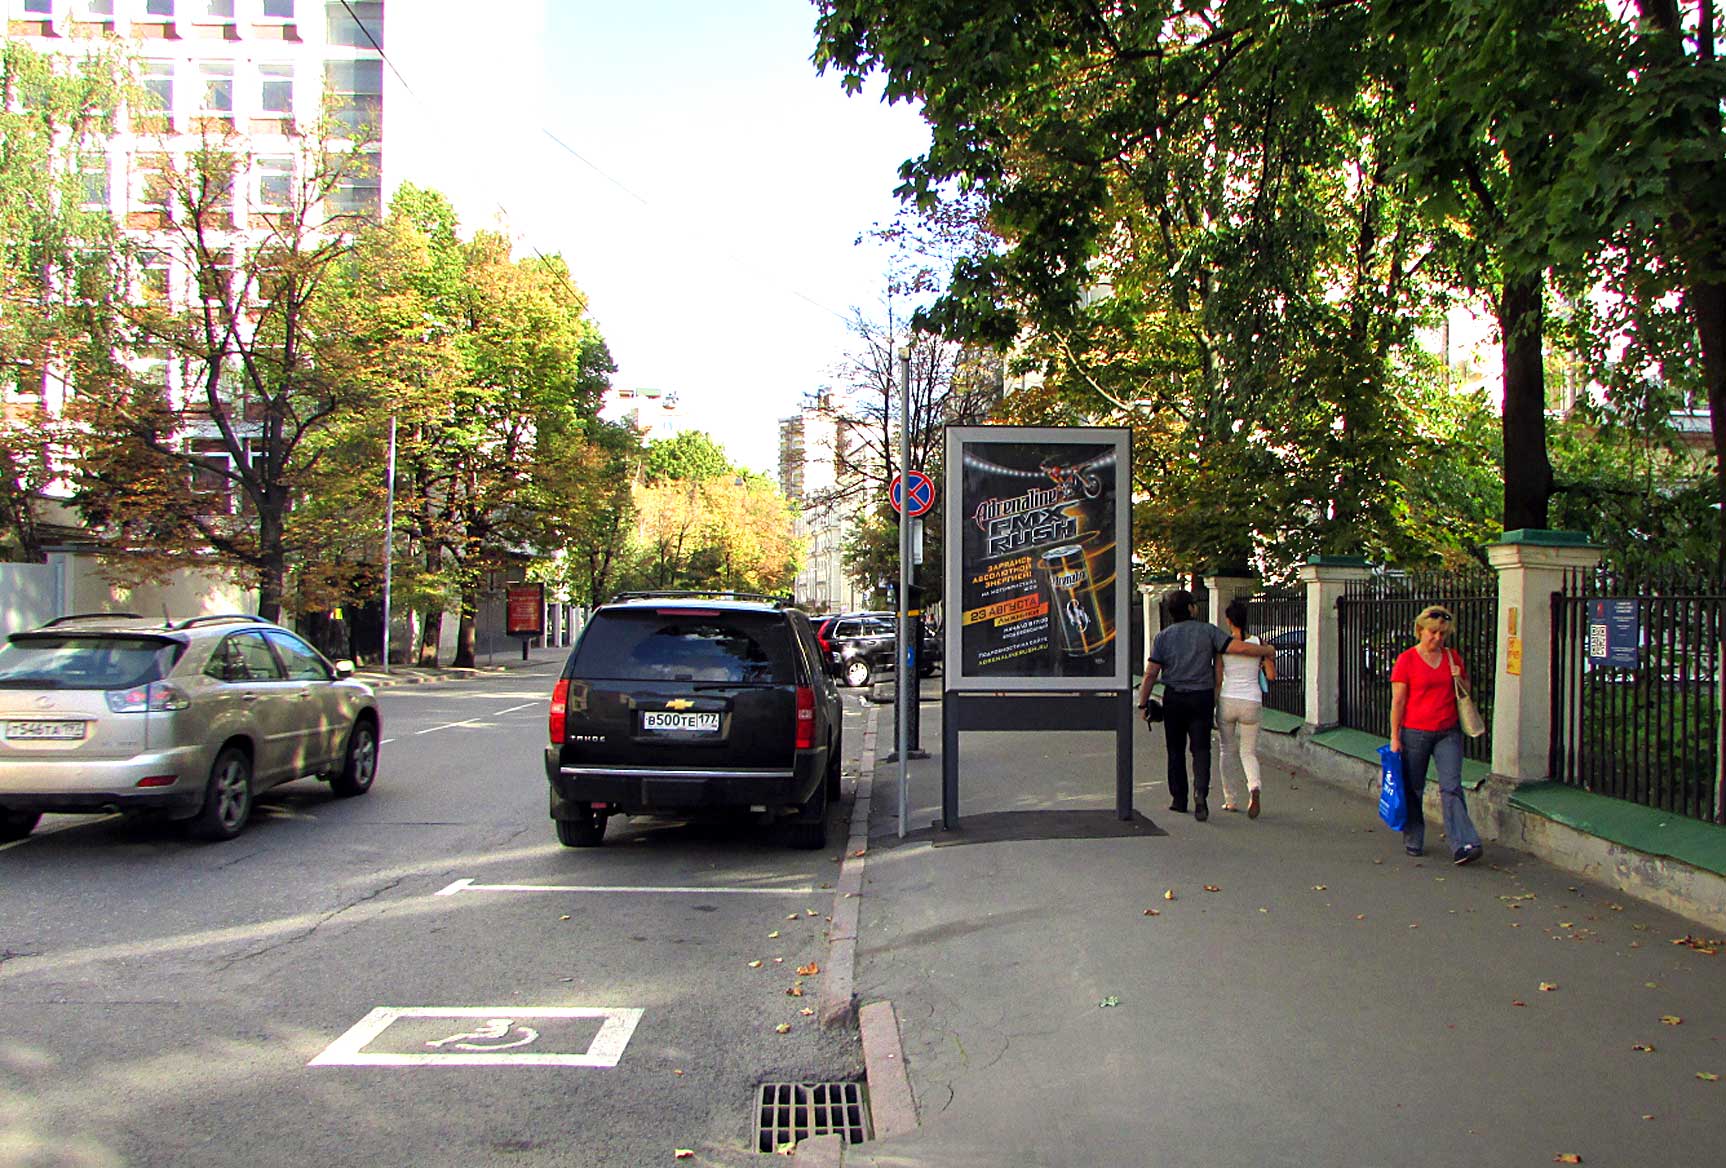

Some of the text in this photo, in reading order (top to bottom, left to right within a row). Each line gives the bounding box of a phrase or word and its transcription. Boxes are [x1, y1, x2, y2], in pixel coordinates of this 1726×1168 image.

[989, 500, 1080, 537] FMX
[987, 516, 1079, 556] RUSH
[972, 564, 1032, 584] АБСОЛЮТНОЙ
[970, 597, 1038, 622] 23 АВГУСТА
[648, 713, 717, 727] В500ТЕ 177
